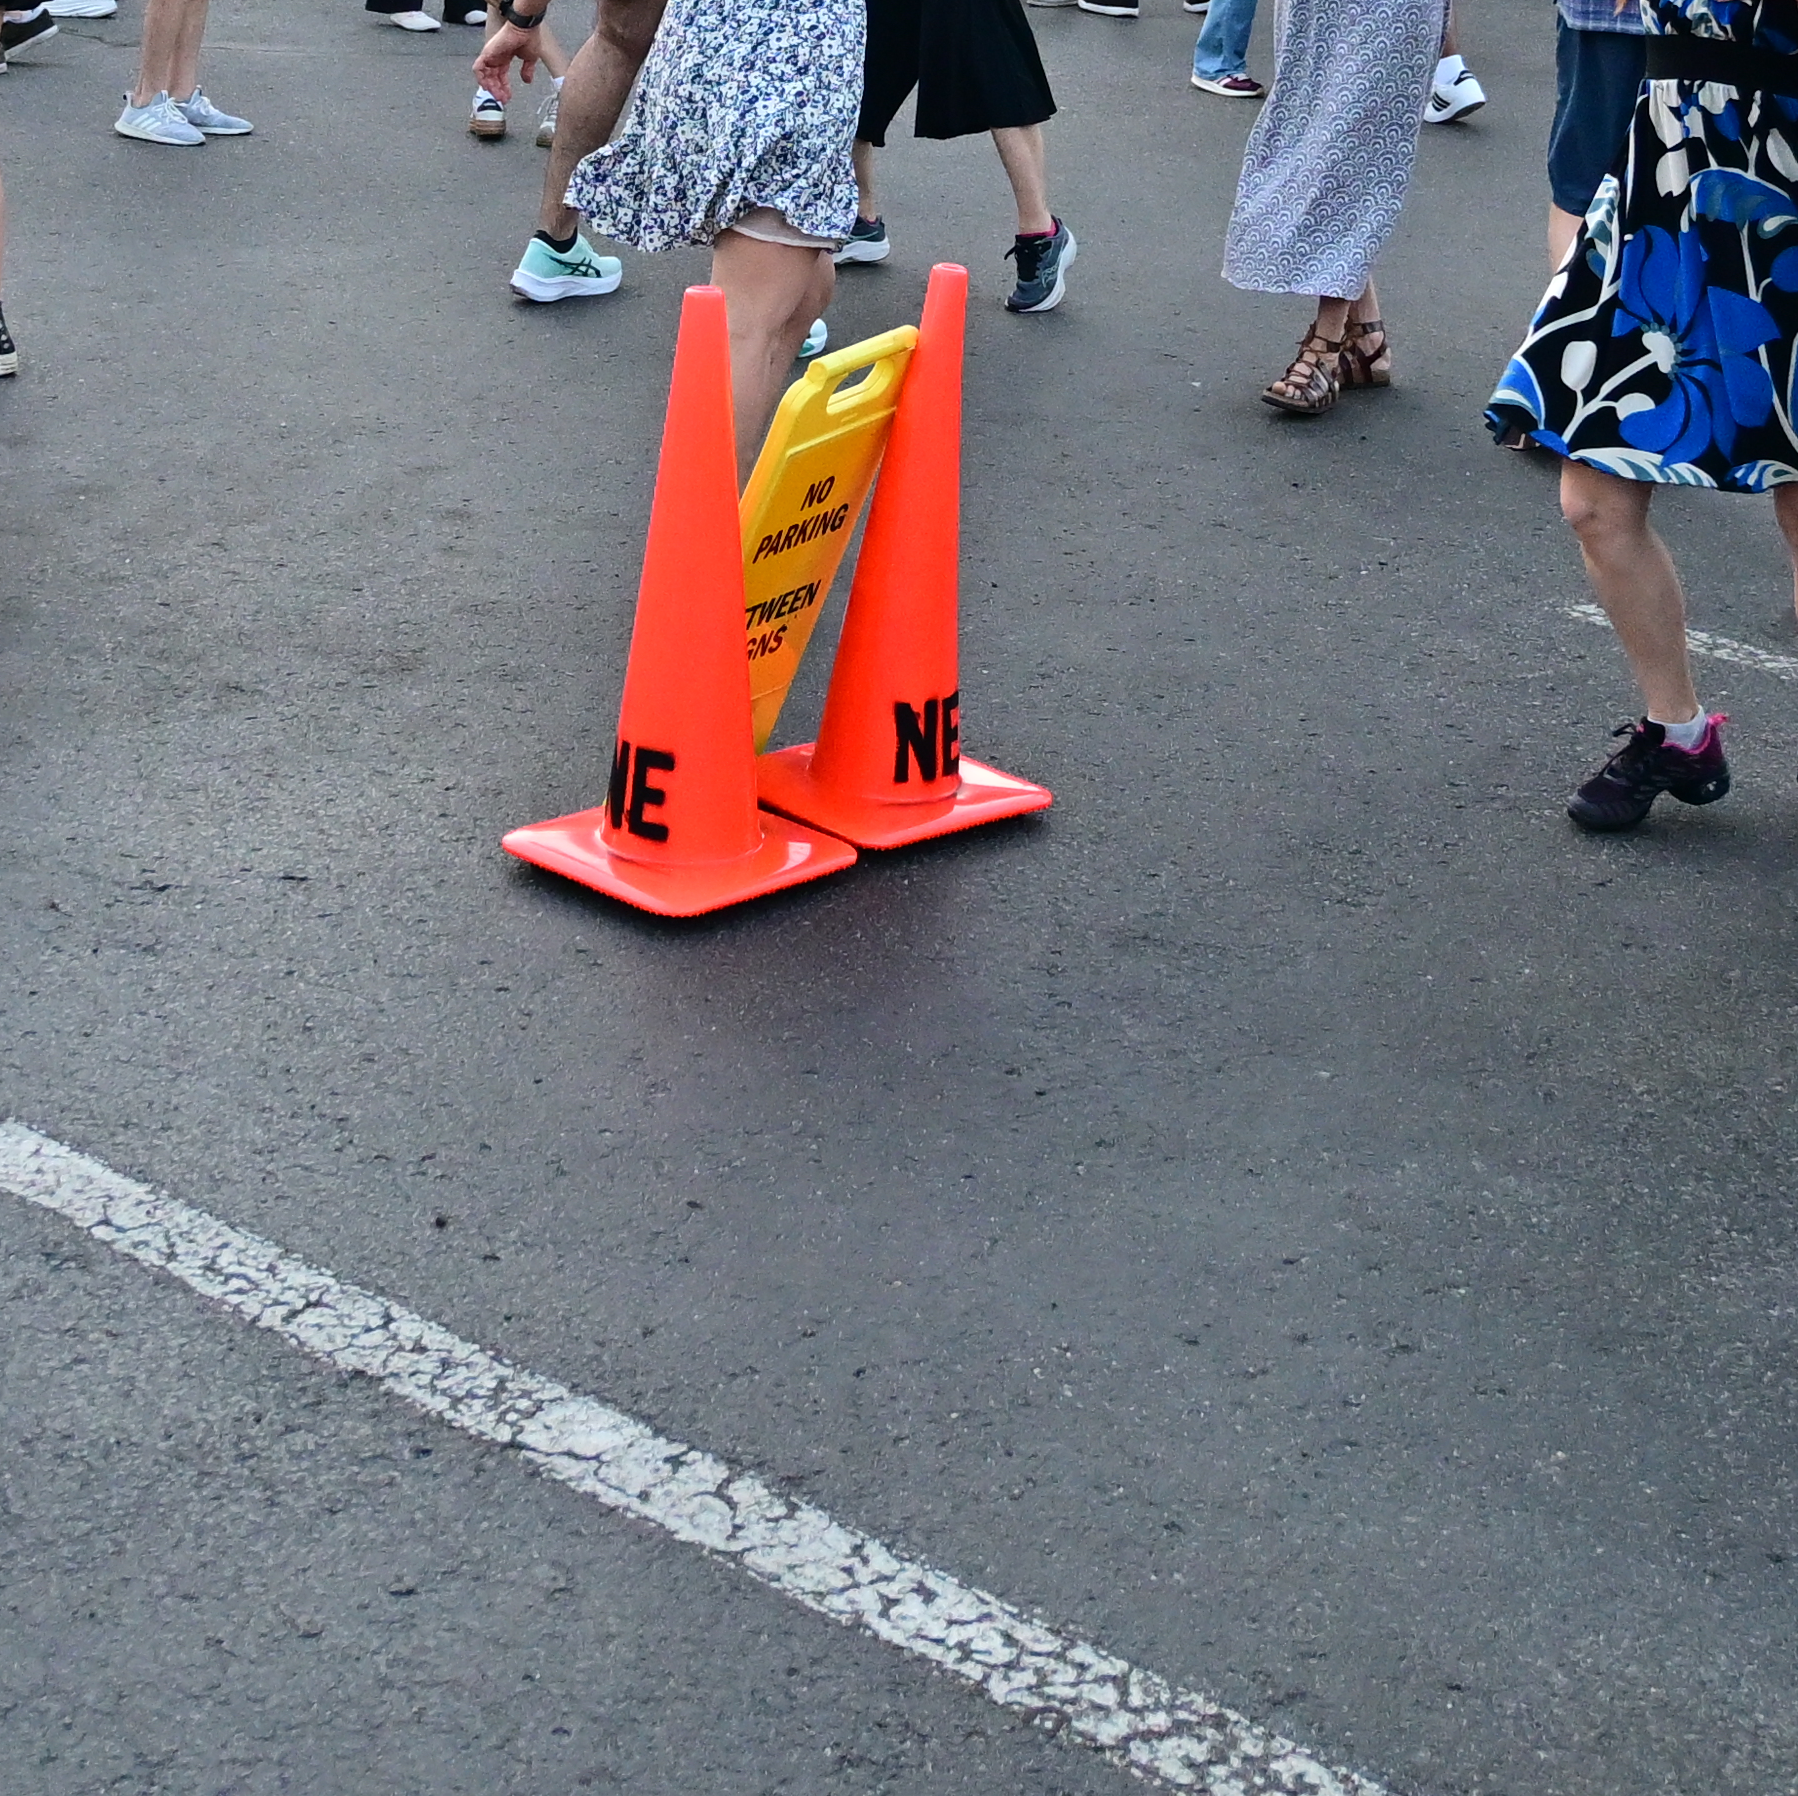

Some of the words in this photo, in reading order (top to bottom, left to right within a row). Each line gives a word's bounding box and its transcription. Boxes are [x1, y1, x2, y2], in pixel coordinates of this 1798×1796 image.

[800, 475, 836, 512] NO
[752, 502, 850, 565] PARKING
[745, 579, 823, 631] TWEEN
[747, 623, 789, 662] GNS
[893, 690, 959, 783] NE
[605, 739, 676, 843] NE
